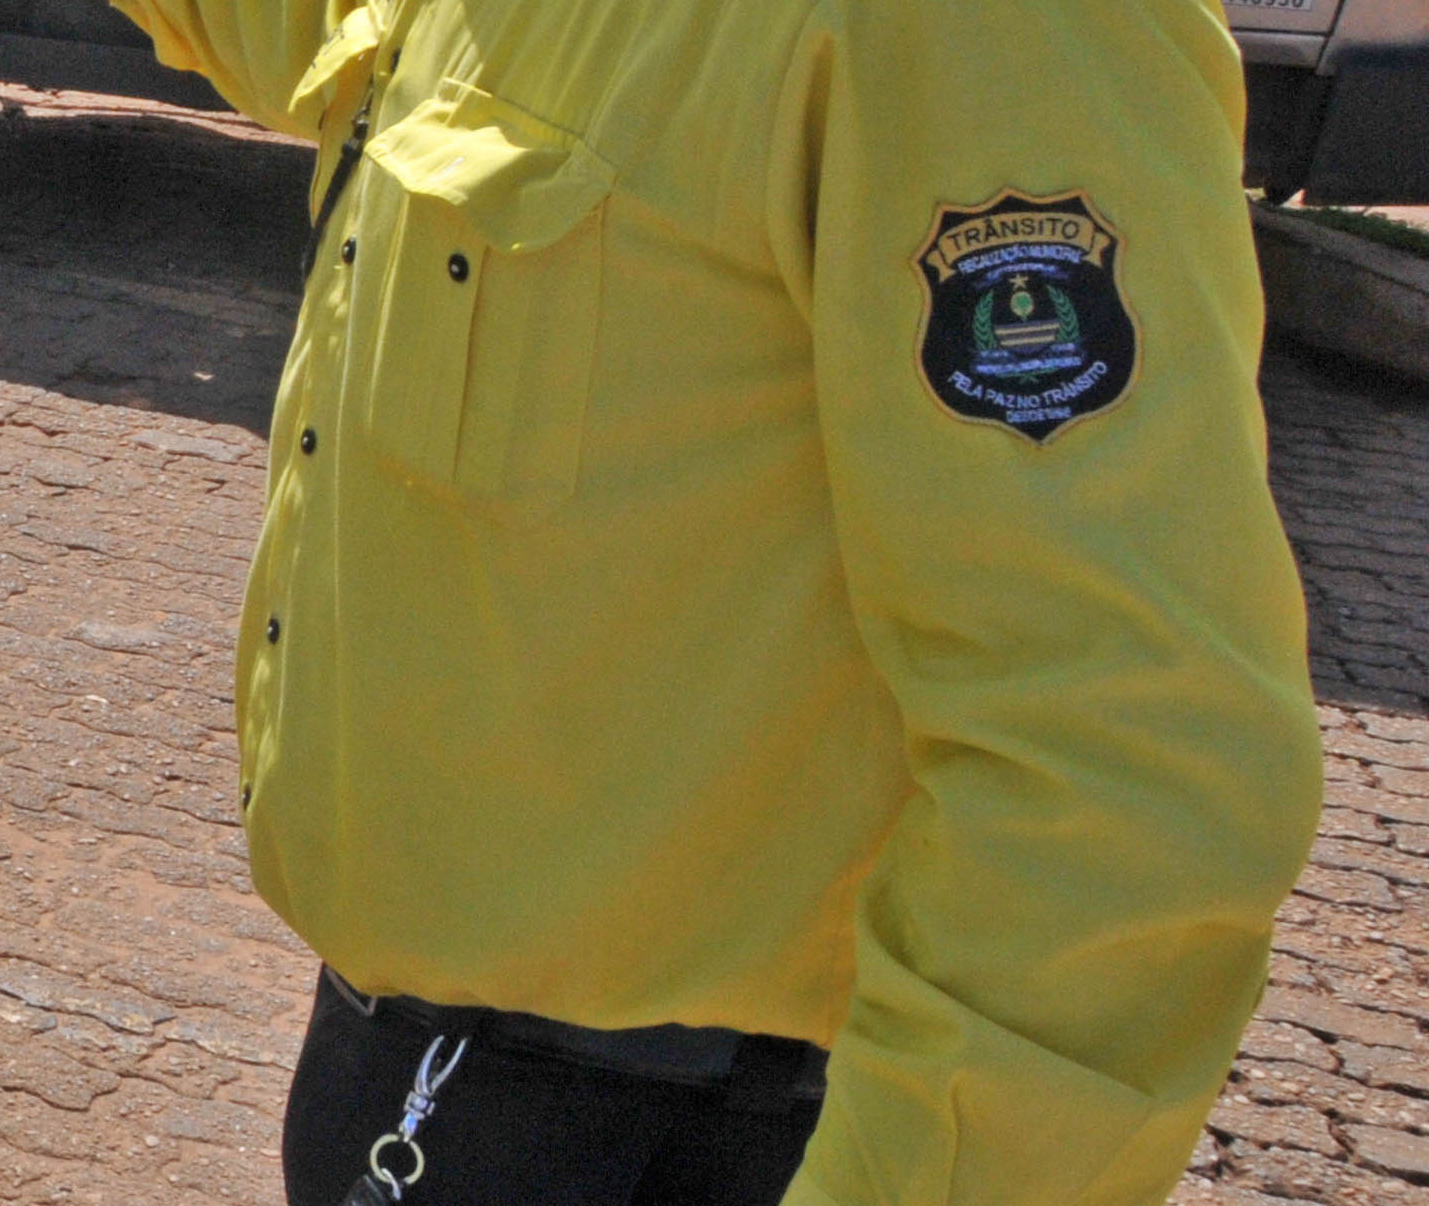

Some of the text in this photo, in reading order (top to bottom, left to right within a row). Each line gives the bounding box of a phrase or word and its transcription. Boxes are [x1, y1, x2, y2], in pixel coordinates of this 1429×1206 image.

[947, 215, 1081, 252] TRÂNSITO
[947, 370, 983, 401] PELA
[984, 387, 1017, 408] PAZ
[1017, 394, 1040, 409] NO
[1042, 360, 1108, 406] TRÂNSITO
